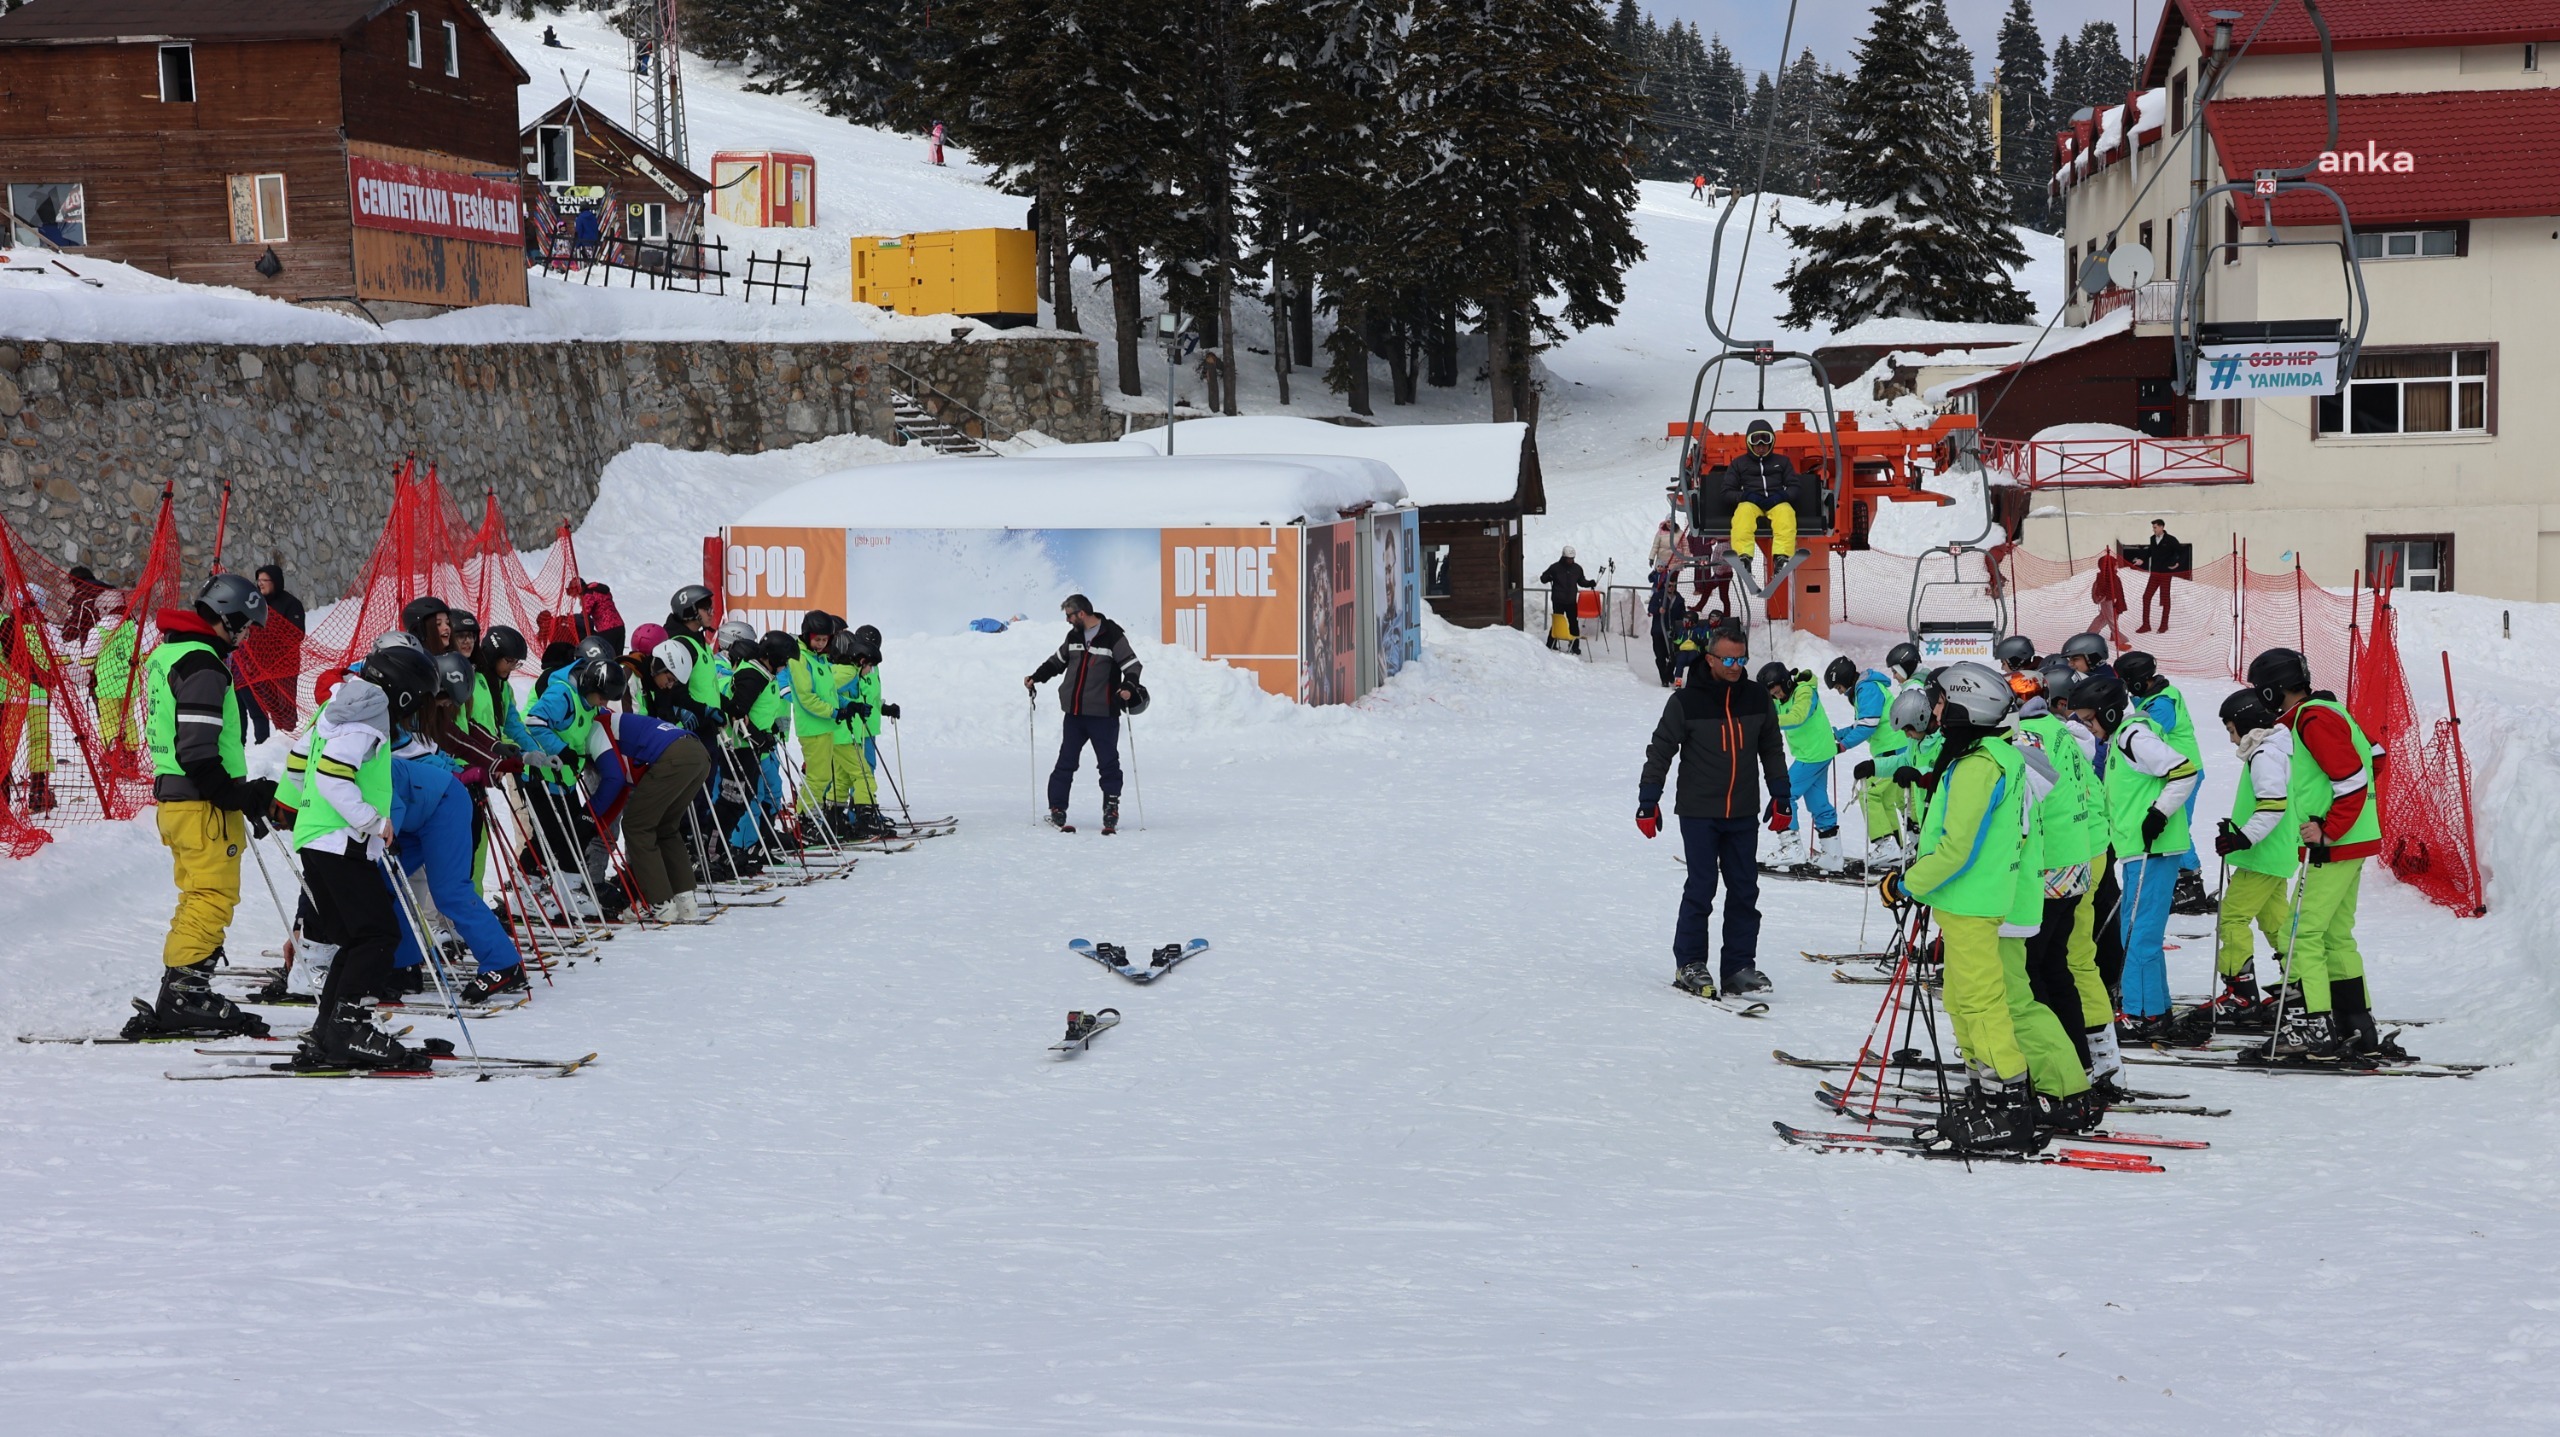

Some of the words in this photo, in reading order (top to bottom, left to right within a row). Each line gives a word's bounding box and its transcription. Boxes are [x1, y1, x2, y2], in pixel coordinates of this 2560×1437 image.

[2257, 182, 2274, 194] 43
[358, 177, 450, 225] CENNETKAYA
[2249, 351, 2284, 367] GSB
[2287, 351, 2318, 366] HEP
[2248, 372, 2323, 388] YANIMDA
[727, 545, 805, 598] SPOR
[1174, 546, 1276, 597] DENGE
[1944, 646, 1987, 655] BAKANLIĞI
[1950, 684, 1972, 693] uvex
